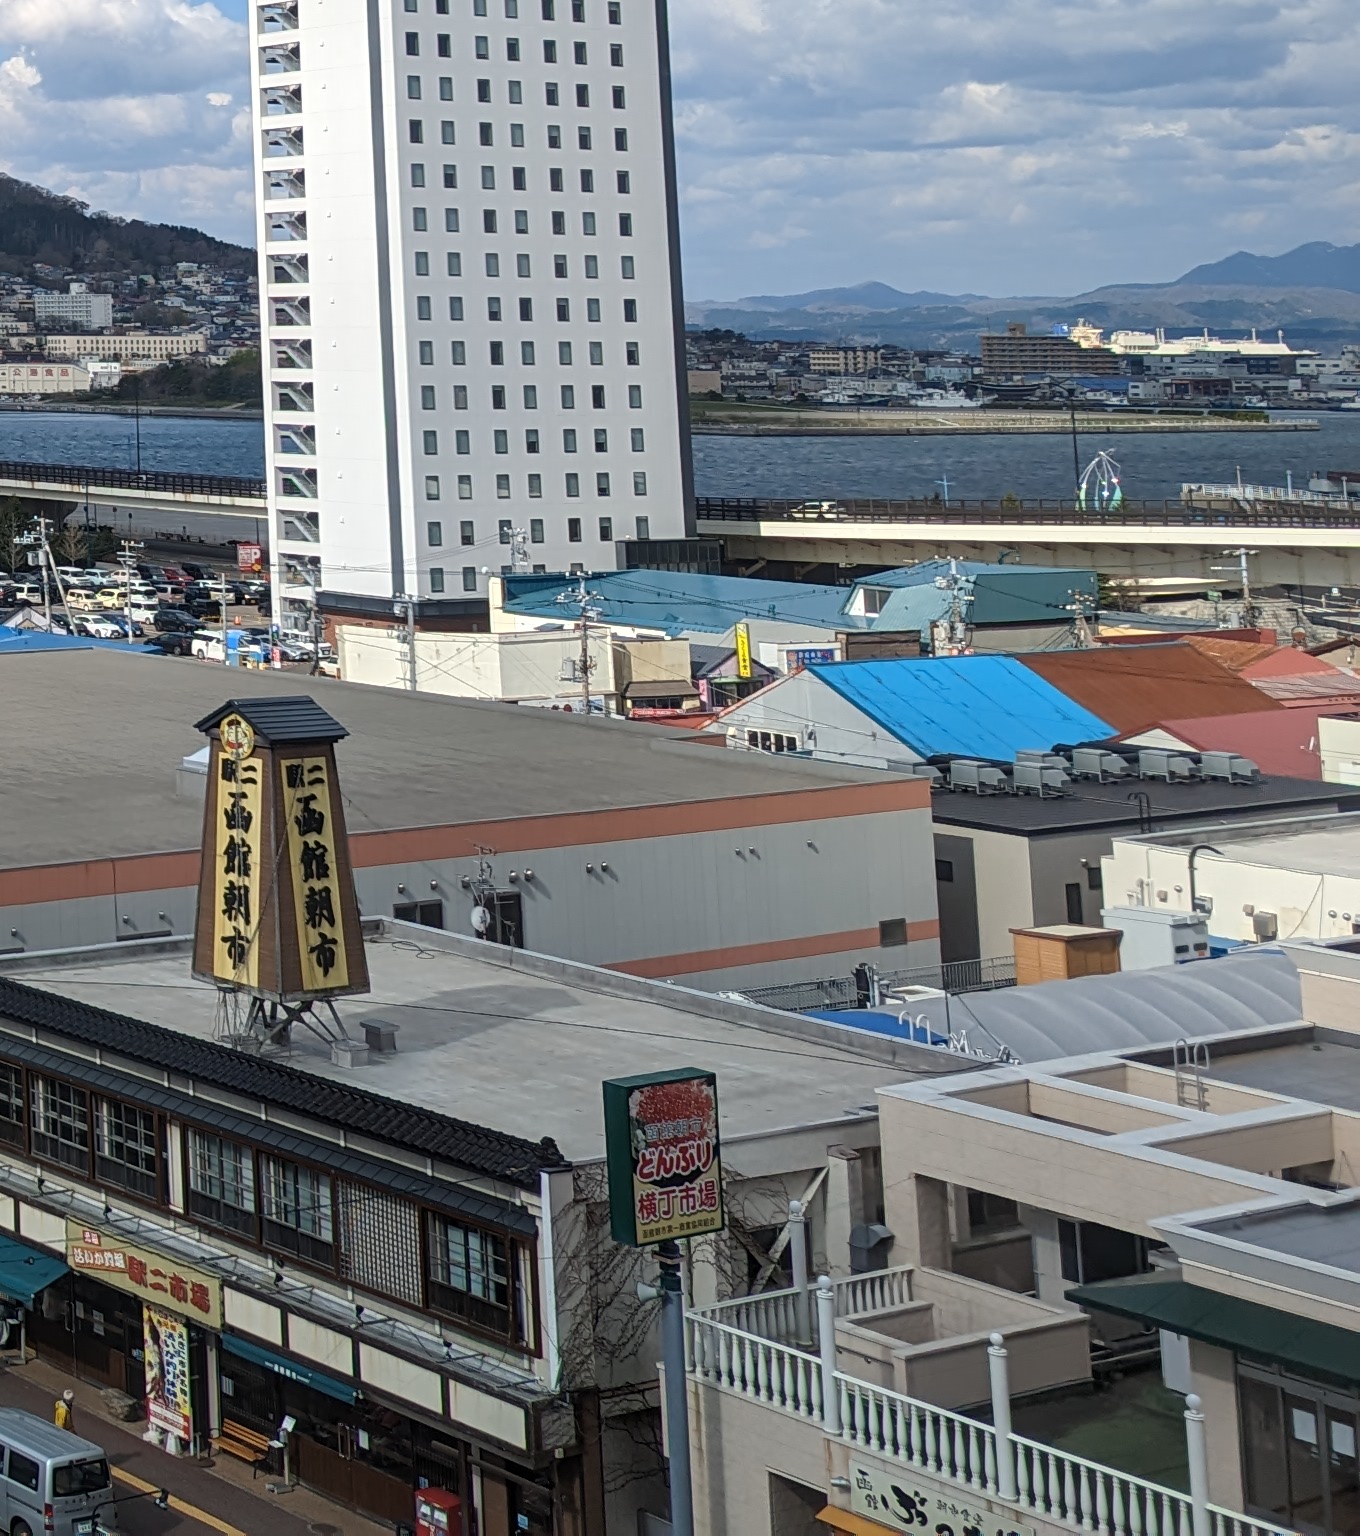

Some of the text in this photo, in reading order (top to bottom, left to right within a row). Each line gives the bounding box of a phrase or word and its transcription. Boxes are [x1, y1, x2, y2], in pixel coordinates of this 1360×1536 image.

[294, 793, 338, 977] 函館朝市
[637, 1140, 713, 1181] どんぶり
[638, 1179, 718, 1222] 横丁市場
